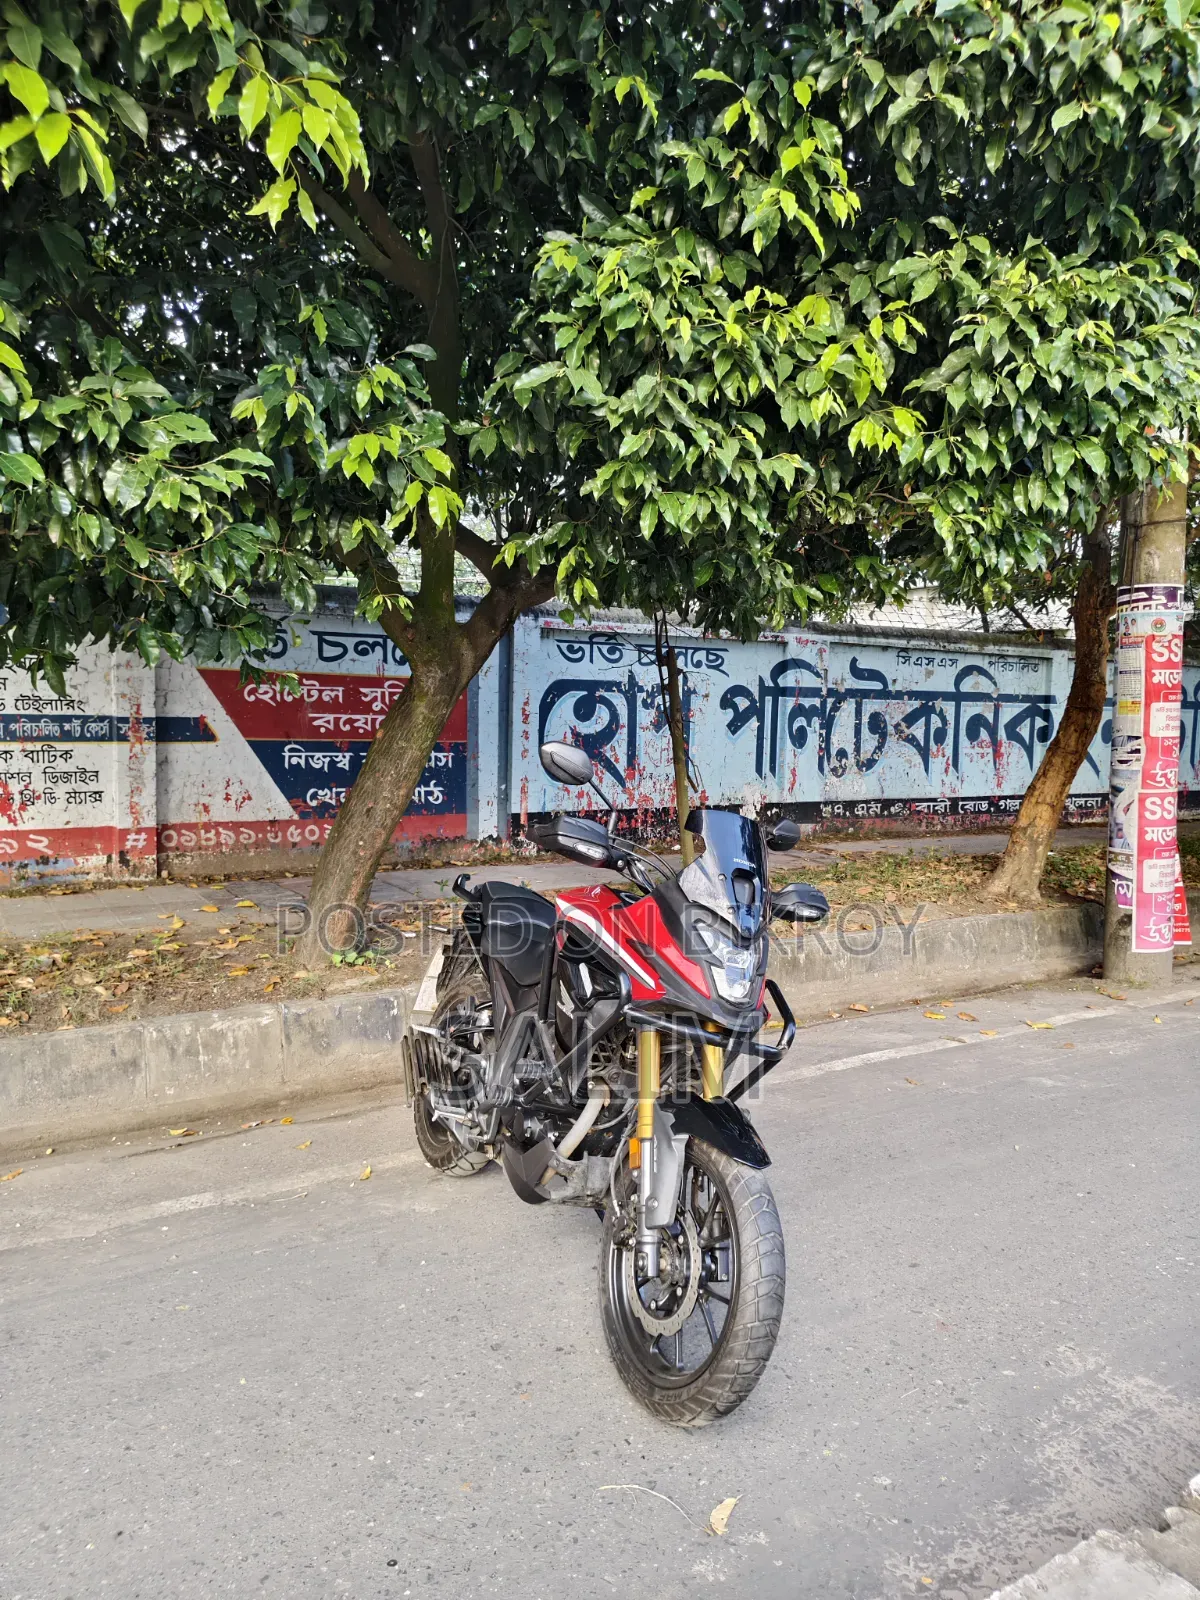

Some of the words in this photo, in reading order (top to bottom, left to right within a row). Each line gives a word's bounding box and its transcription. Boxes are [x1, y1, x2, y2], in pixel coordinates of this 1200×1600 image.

[987, 655, 1040, 673] পরিচালিত
[14, 693, 86, 713] টেইলারিং
[24, 743, 74, 764] বাটিক
[281, 744, 355, 773] নিজস্ব
[41, 766, 100, 785] ডিজাইন
